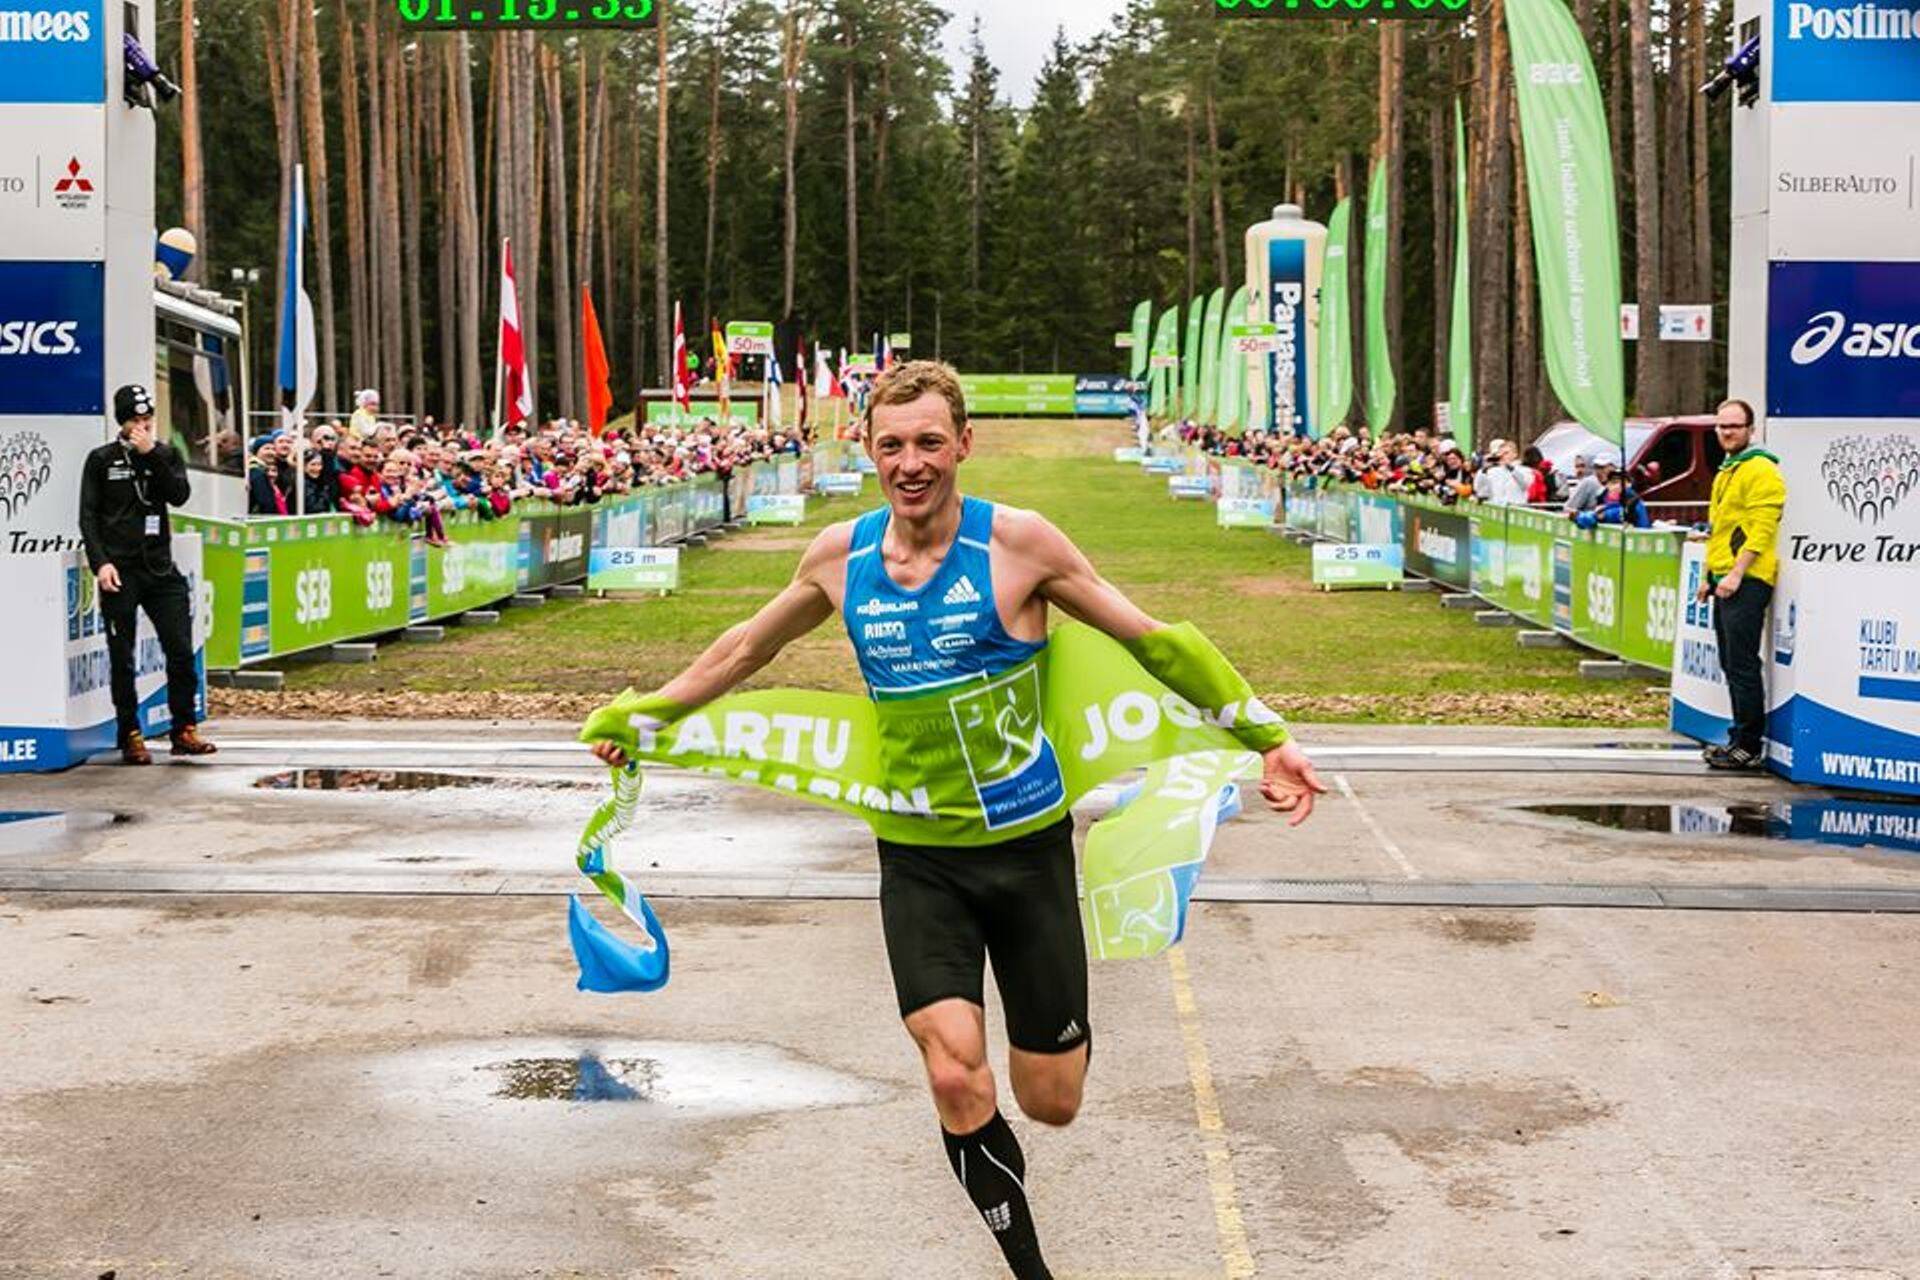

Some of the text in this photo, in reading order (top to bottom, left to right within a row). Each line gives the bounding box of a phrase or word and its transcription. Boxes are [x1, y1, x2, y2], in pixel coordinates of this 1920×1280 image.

[1274, 282, 1302, 437] Panasonic
[611, 551, 656, 564] 25 m
[1335, 547, 1381, 560] 25 m
[1791, 535, 1866, 562] Terve
[296, 568, 331, 624] SEB
[1860, 619, 1897, 645] KLUBI
[1860, 646, 1899, 672] TARTU
[628, 710, 850, 769] TARTU
